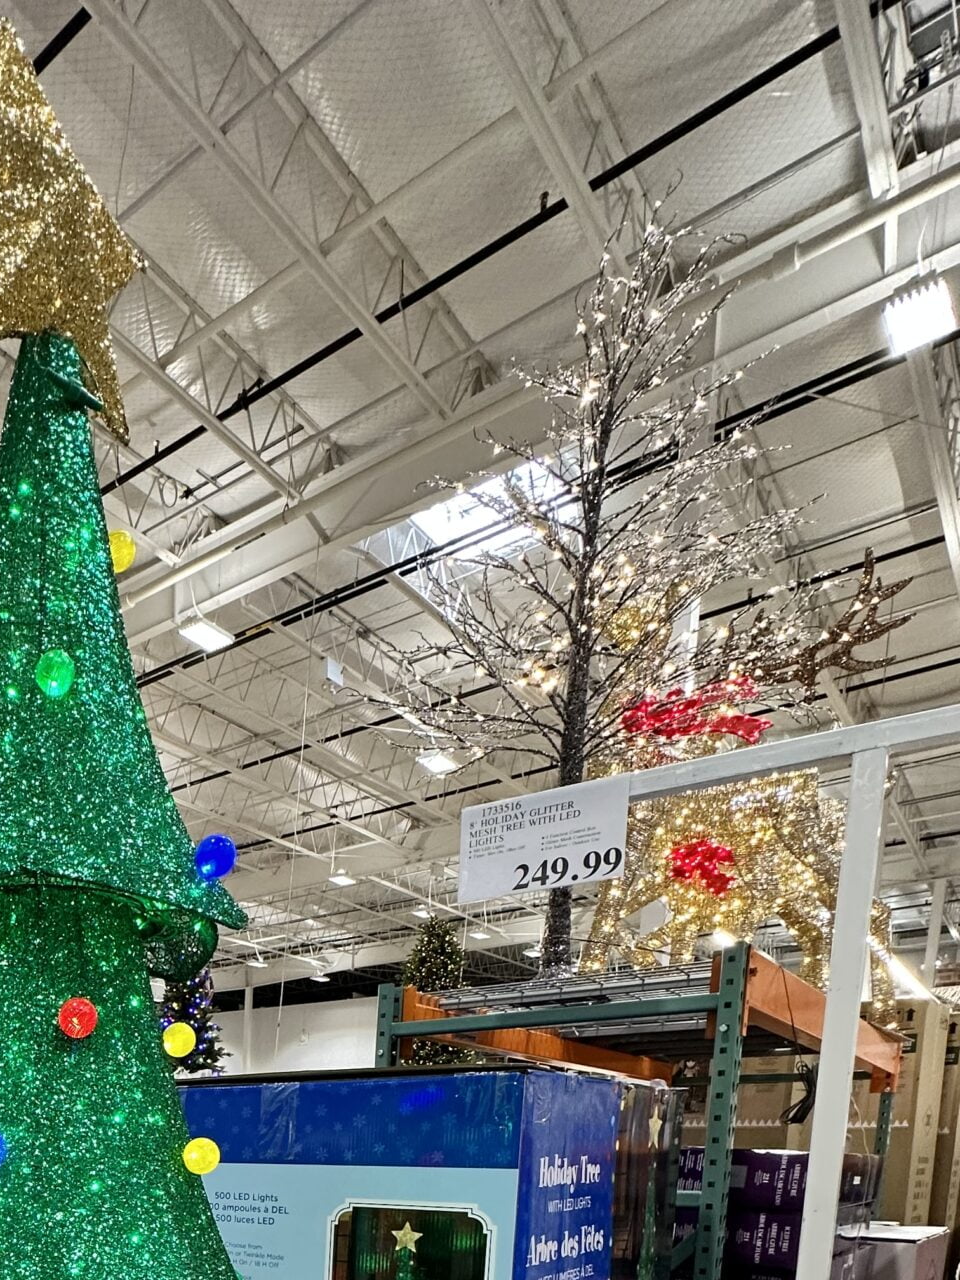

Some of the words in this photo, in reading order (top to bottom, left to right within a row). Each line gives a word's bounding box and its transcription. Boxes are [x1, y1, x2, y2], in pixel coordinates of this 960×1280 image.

[480, 811, 526, 827] HOLIDAY
[529, 800, 575, 817] GLITTER
[482, 800, 522, 817] 1733516
[470, 826, 497, 839] MESH
[501, 819, 526, 833] TREE
[528, 814, 556, 827] WITH
[560, 809, 581, 821] LED
[469, 834, 504, 848] LIGHTS
[512, 847, 623, 891] 249.99
[538, 1154, 578, 1194] Holiday
[580, 1155, 601, 1184] Tree
[214, 1192, 230, 1200] 500
[233, 1192, 250, 1201] LED
[252, 1193, 278, 1202] Lights
[548, 1200, 562, 1213] WITH
[564, 1198, 574, 1212] LED
[574, 1196, 592, 1210] LIGHTS
[222, 1204, 261, 1214] ampoules
[272, 1206, 289, 1214] DEL
[215, 1214, 232, 1222] 500
[234, 1215, 254, 1224] luces
[258, 1217, 275, 1225] LED
[526, 1234, 558, 1268] Arbre
[561, 1230, 578, 1258] des
[580, 1224, 604, 1254] Fêtes
